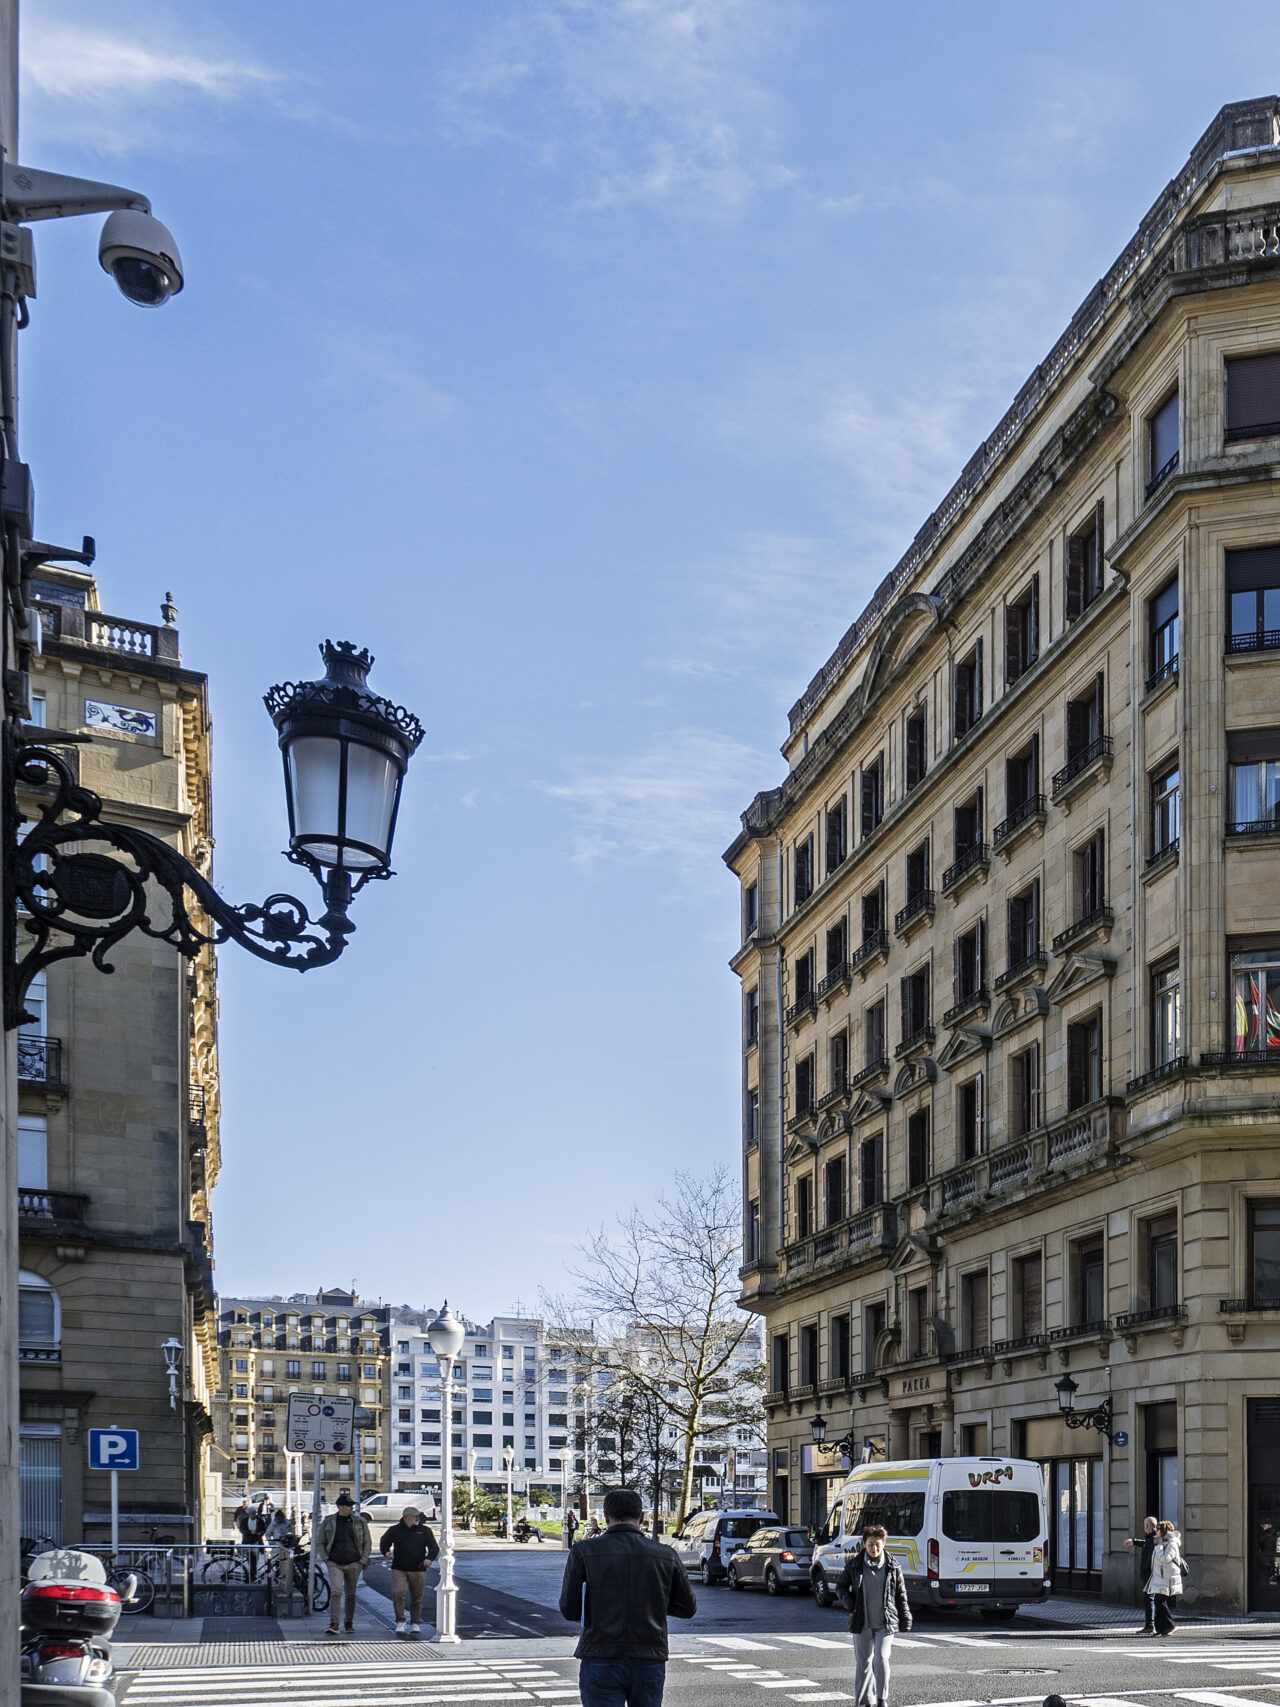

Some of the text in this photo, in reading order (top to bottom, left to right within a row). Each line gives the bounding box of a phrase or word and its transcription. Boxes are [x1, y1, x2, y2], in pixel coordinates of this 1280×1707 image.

[902, 1377, 930, 1393] PAKEA
[100, 1434, 127, 1464] P
[968, 1465, 1013, 1488] URPA
